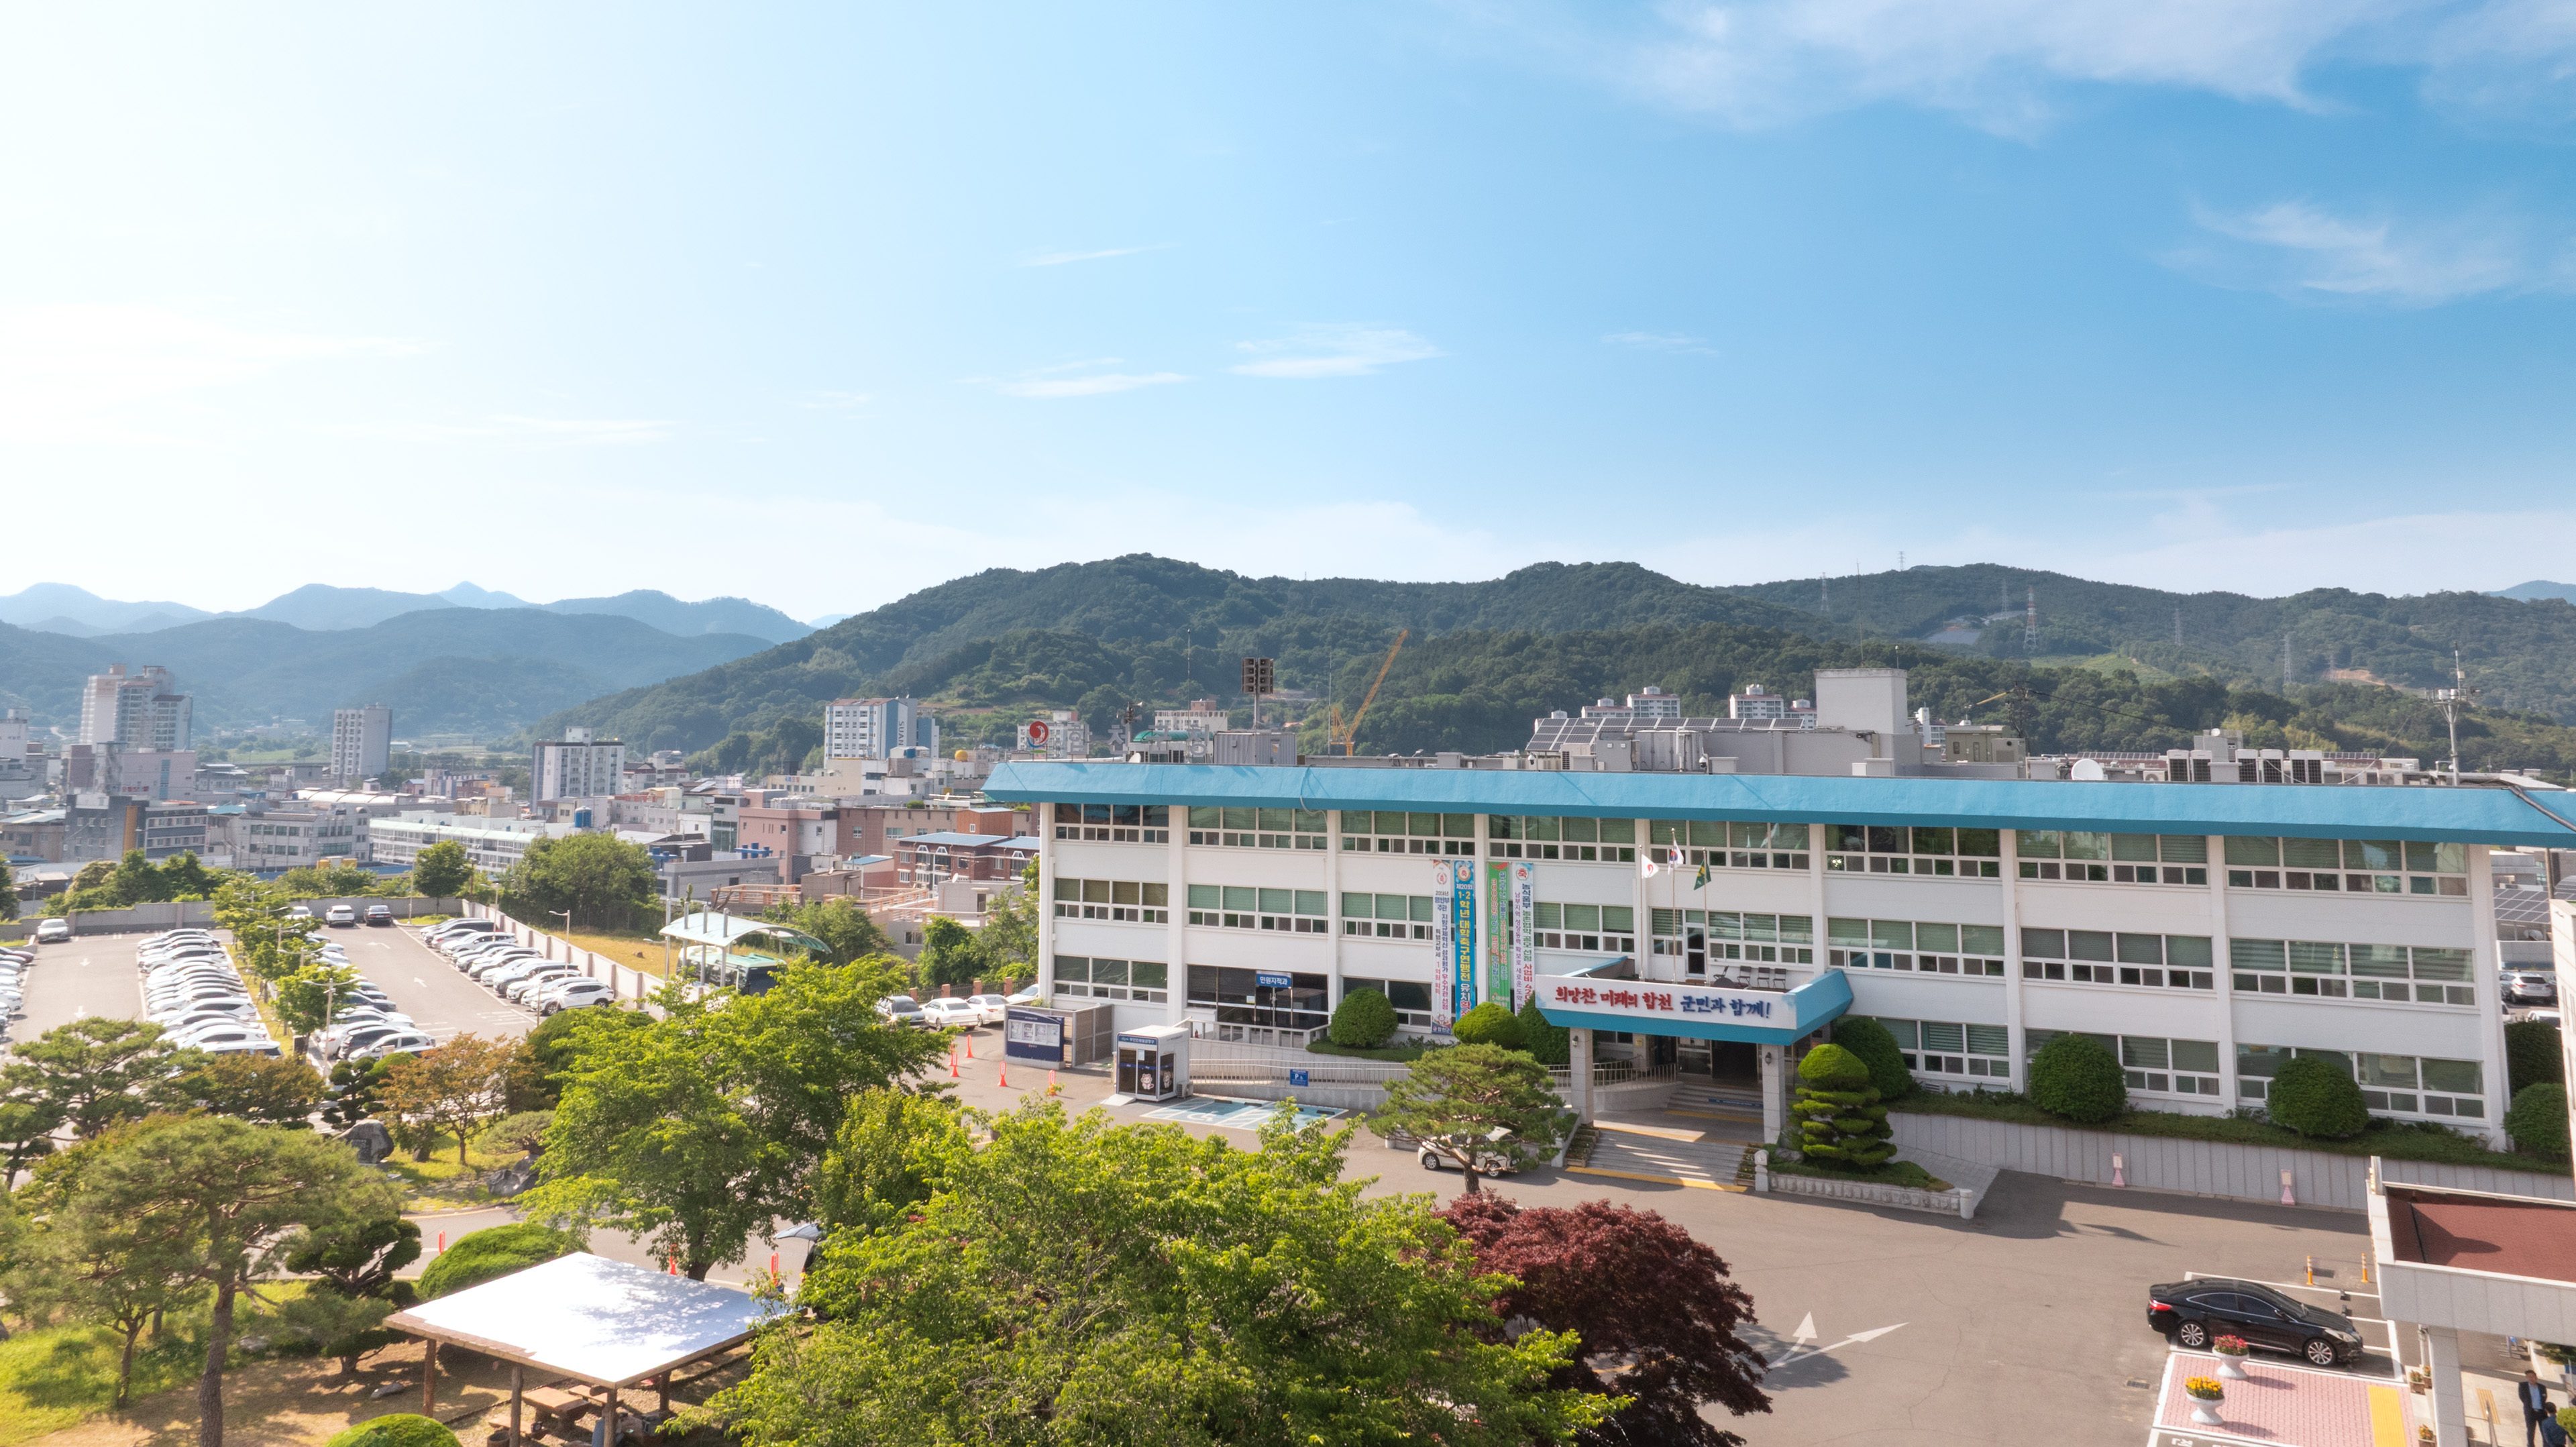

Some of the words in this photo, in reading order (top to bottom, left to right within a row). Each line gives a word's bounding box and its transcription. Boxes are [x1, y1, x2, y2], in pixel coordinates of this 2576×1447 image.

[1517, 868, 1527, 879] 축
[1459, 900, 1470, 918] 학년
[1523, 949, 1532, 962] 선정
[1523, 963, 1533, 982] 사업비
[1260, 976, 1287, 985] 민원지적과
[1442, 998, 1448, 1010] 선정
[1555, 985, 1597, 1004] 희망찬
[1600, 989, 1638, 1008] 미래의
[1642, 992, 1674, 1011] 합천
[1680, 996, 1726, 1014] 군민과
[1729, 998, 1771, 1018] 함께!
